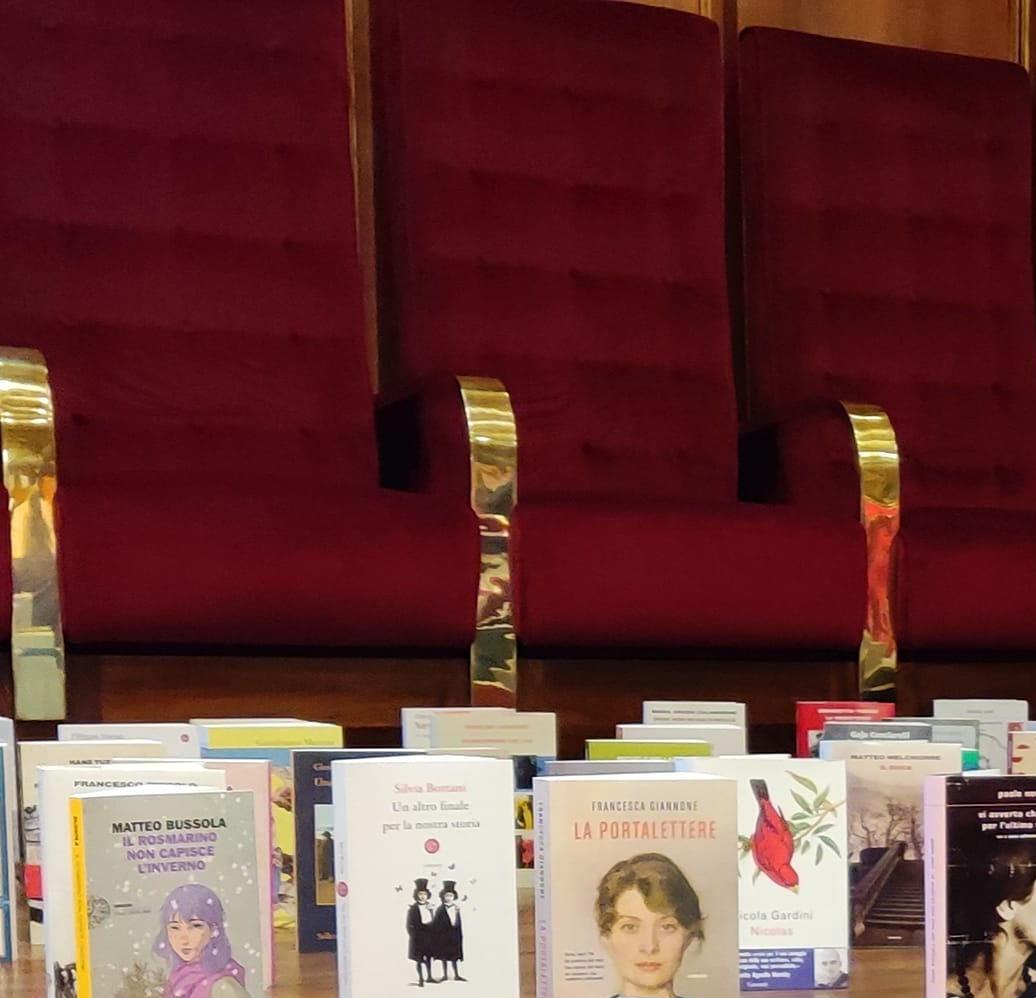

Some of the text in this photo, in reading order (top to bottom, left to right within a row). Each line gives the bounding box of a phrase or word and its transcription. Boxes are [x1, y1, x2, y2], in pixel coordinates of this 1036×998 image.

[394, 783, 423, 793] Silvia
[392, 801, 469, 812] Un altro finale
[591, 800, 699, 811] FRANCESCA GIANNONE
[112, 817, 227, 834] MATTEO BUSSOLA
[382, 818, 481, 835] per la nostra storia
[574, 820, 717, 840] LA PORTALETTERE
[122, 832, 218, 847] IL ROSMARINO
[126, 846, 215, 861] NON CAPISCE
[138, 860, 206, 874] L'INVERNO
[739, 909, 813, 921] icola Gardini
